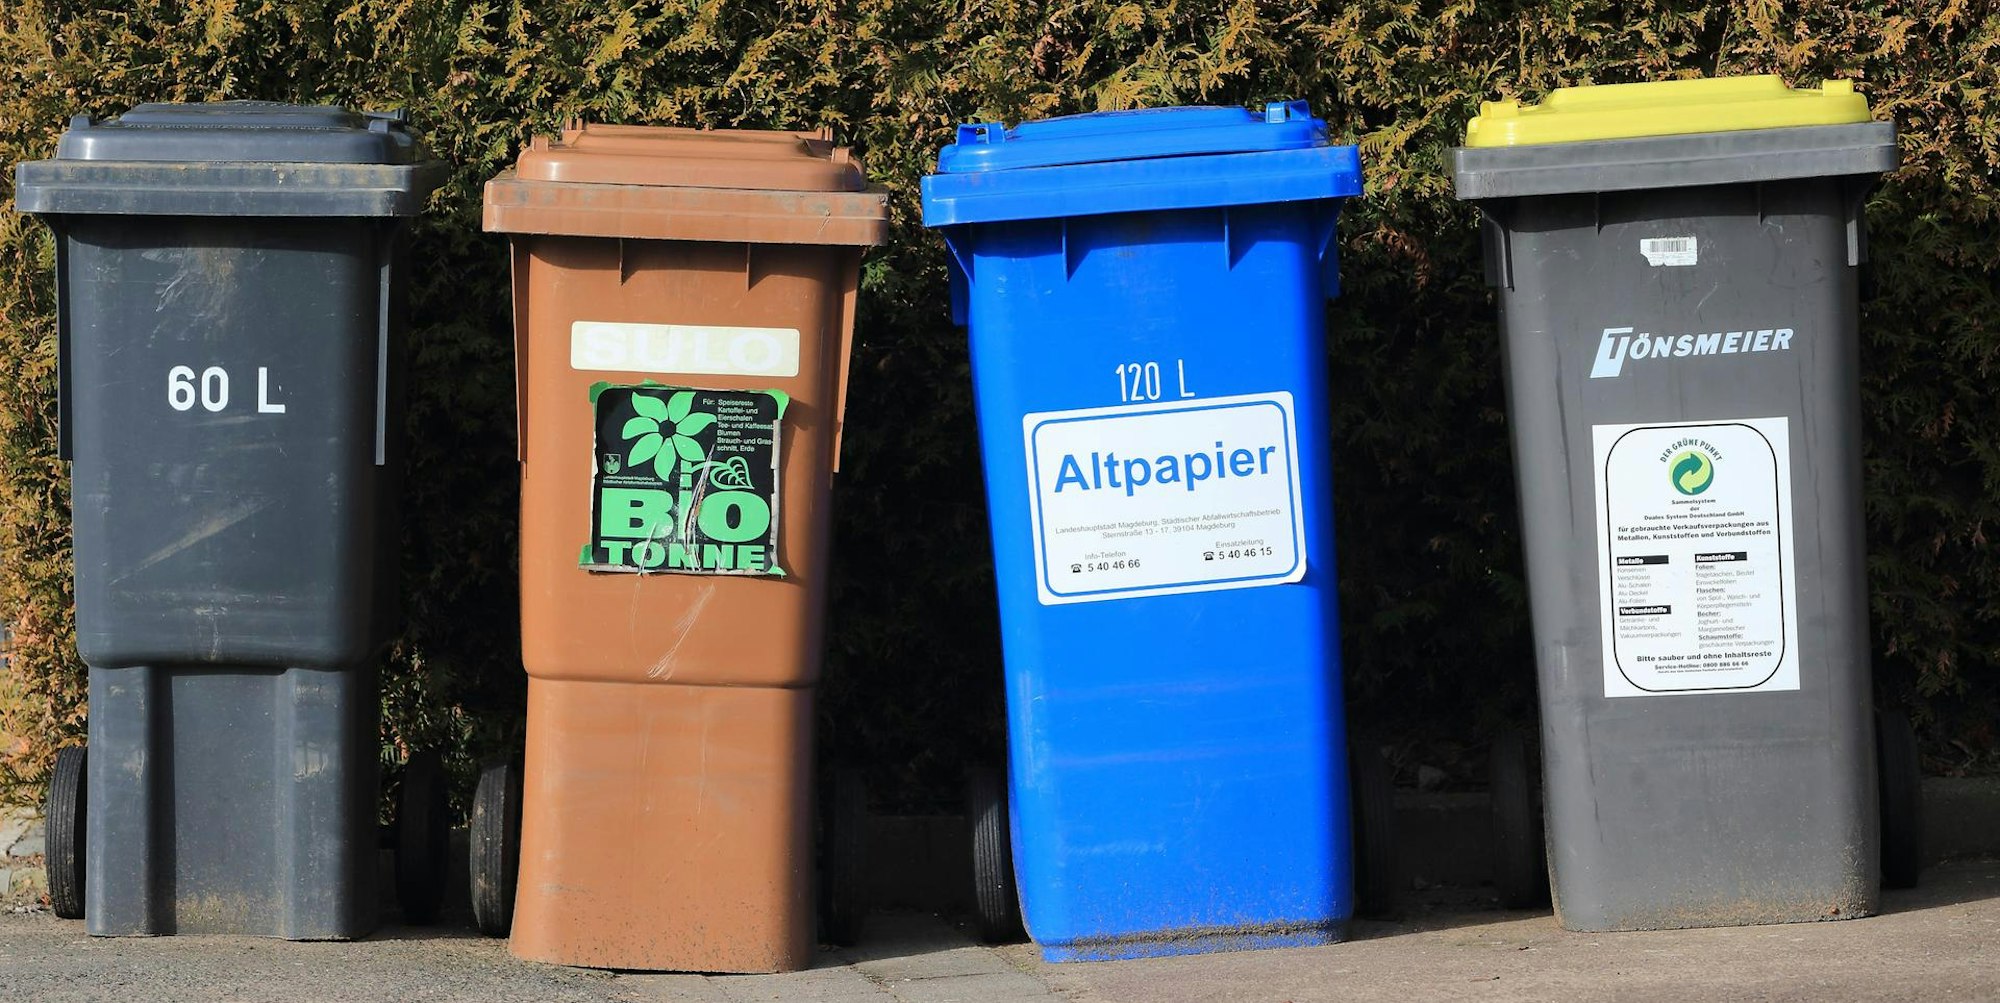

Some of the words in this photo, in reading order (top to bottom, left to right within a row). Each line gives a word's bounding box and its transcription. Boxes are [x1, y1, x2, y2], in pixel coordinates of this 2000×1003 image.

[583, 325, 782, 373] SULO
[1590, 327, 1794, 378] TÖNSMEIER
[167, 365, 231, 414] 60
[257, 366, 287, 414] L
[1115, 361, 1161, 402] 120
[1178, 359, 1196, 398] L
[1660, 448, 1673, 462] DER
[1700, 440, 1723, 461] PUNKT
[1054, 440, 1276, 497] Altpapier
[601, 487, 771, 542] BIO
[1056, 522, 1116, 534] Landeshauptstadt
[1161, 516, 1200, 525] Städtischer
[1202, 508, 1280, 520] Abfallwirtschaftsbetrieb
[1102, 530, 1142, 539] Sternstraße
[1145, 528, 1154, 536] 13
[1173, 524, 1194, 533] 39104
[1196, 522, 1236, 531] Magdeburg
[1618, 534, 1651, 542] Metallen,
[1716, 529, 1772, 538] Verbundstoffen
[1630, 525, 1671, 534] gebrauchte
[1673, 520, 1754, 530] Verkaufsverpackungen
[1216, 538, 1264, 548] Einsatzleitung
[1219, 551, 1225, 560] 5
[1228, 550, 1240, 558] 40
[1244, 548, 1256, 557] 46
[1260, 547, 1272, 556] 15
[600, 540, 766, 569] TONNE
[1085, 551, 1126, 560] Info-Telefon
[1088, 563, 1094, 572] 5
[1097, 562, 1110, 571] 40
[1112, 560, 1126, 570] 46
[1128, 558, 1140, 568] 66
[1696, 554, 1735, 562] Kunststoffe
